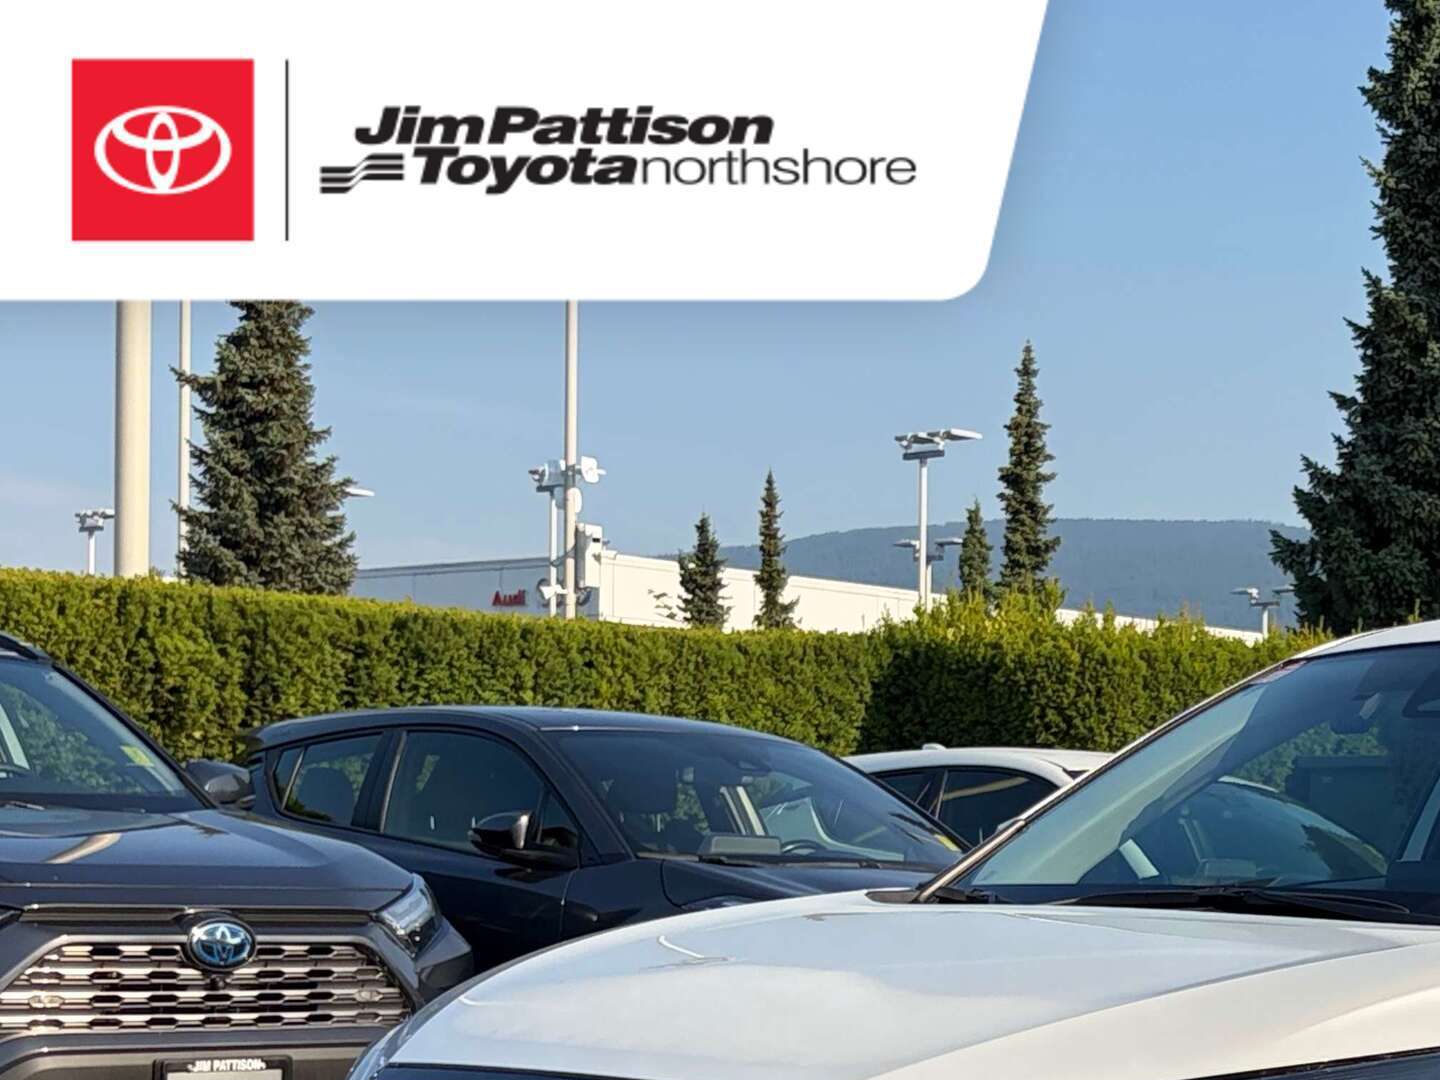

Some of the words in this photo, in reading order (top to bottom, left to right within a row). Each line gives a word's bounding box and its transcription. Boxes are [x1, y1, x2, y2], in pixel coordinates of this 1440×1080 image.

[492, 589, 526, 606] Audi
[191, 1060, 212, 1072] JIM
[213, 1058, 262, 1071] PATTISON
